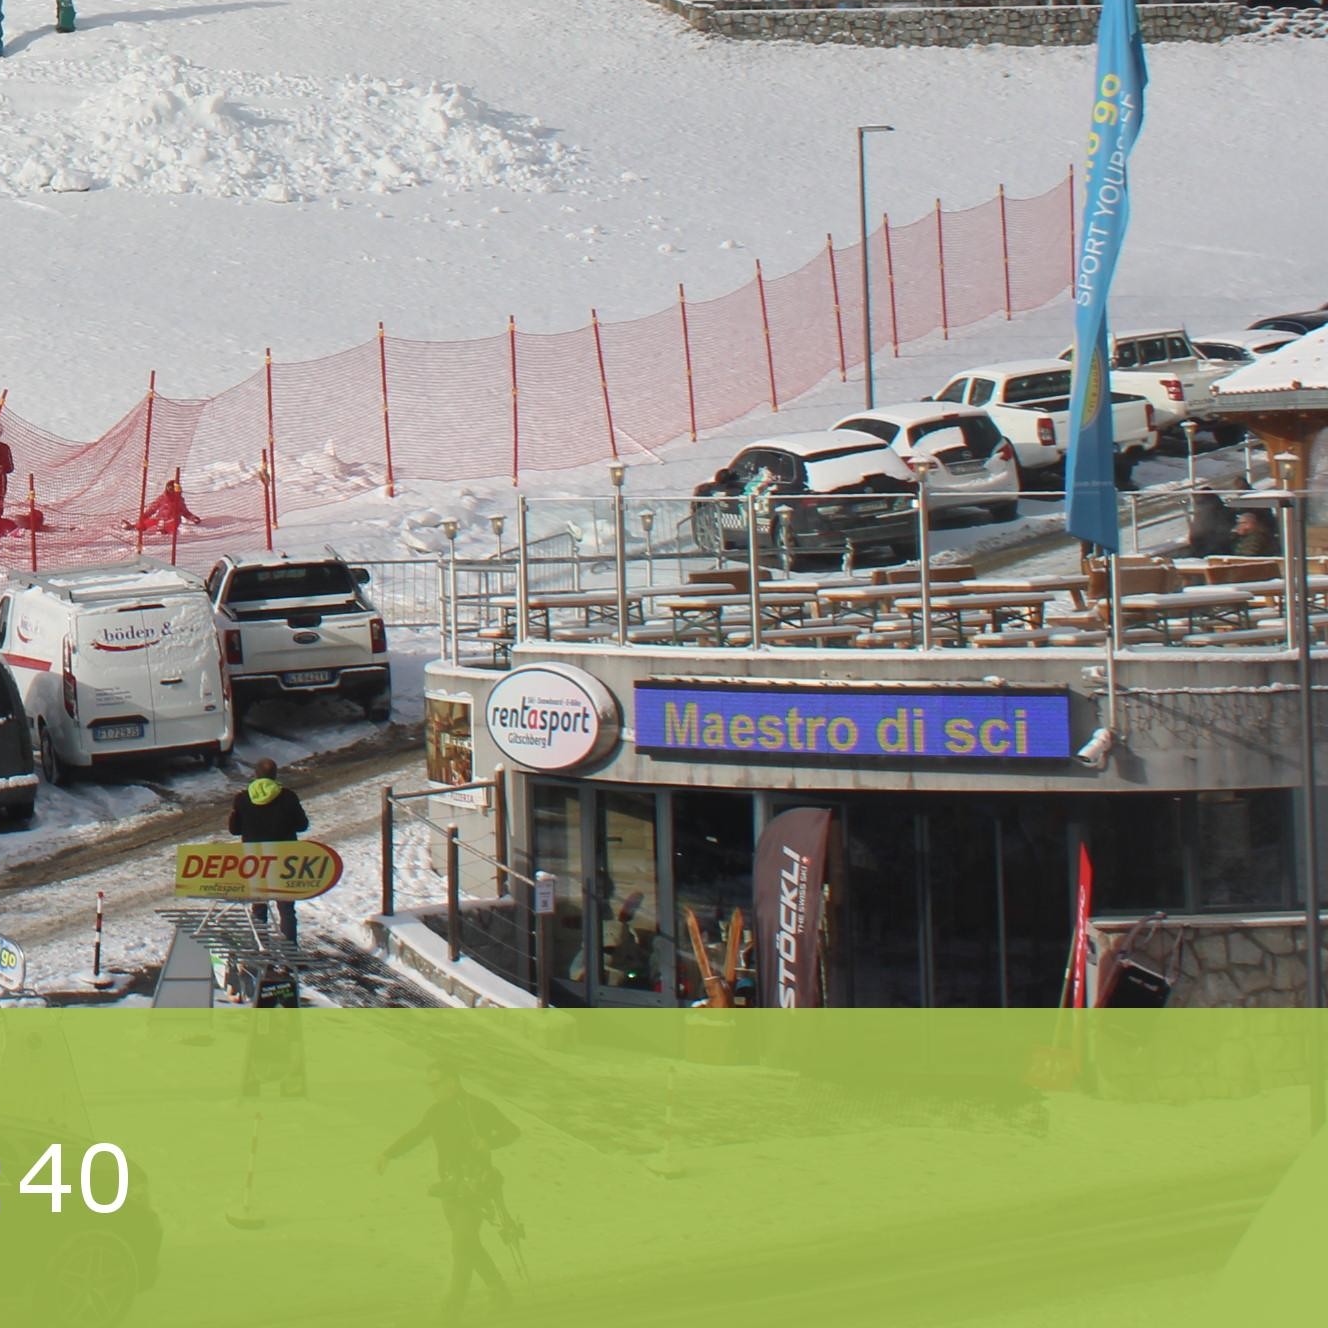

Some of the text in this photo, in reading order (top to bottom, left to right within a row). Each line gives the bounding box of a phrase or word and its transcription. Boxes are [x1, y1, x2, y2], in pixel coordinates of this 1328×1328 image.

[1077, 221, 1109, 306] SPORT
[103, 626, 155, 642] böden
[491, 695, 590, 747] rentasport
[664, 701, 1028, 755] Maestro di sci
[507, 732, 546, 749] Gitschberg
[181, 854, 330, 880] DEPOT SKI
[286, 879, 322, 889] SERVICE
[776, 845, 801, 1008] STÖCKLI
[0, 947, 17, 969] go
